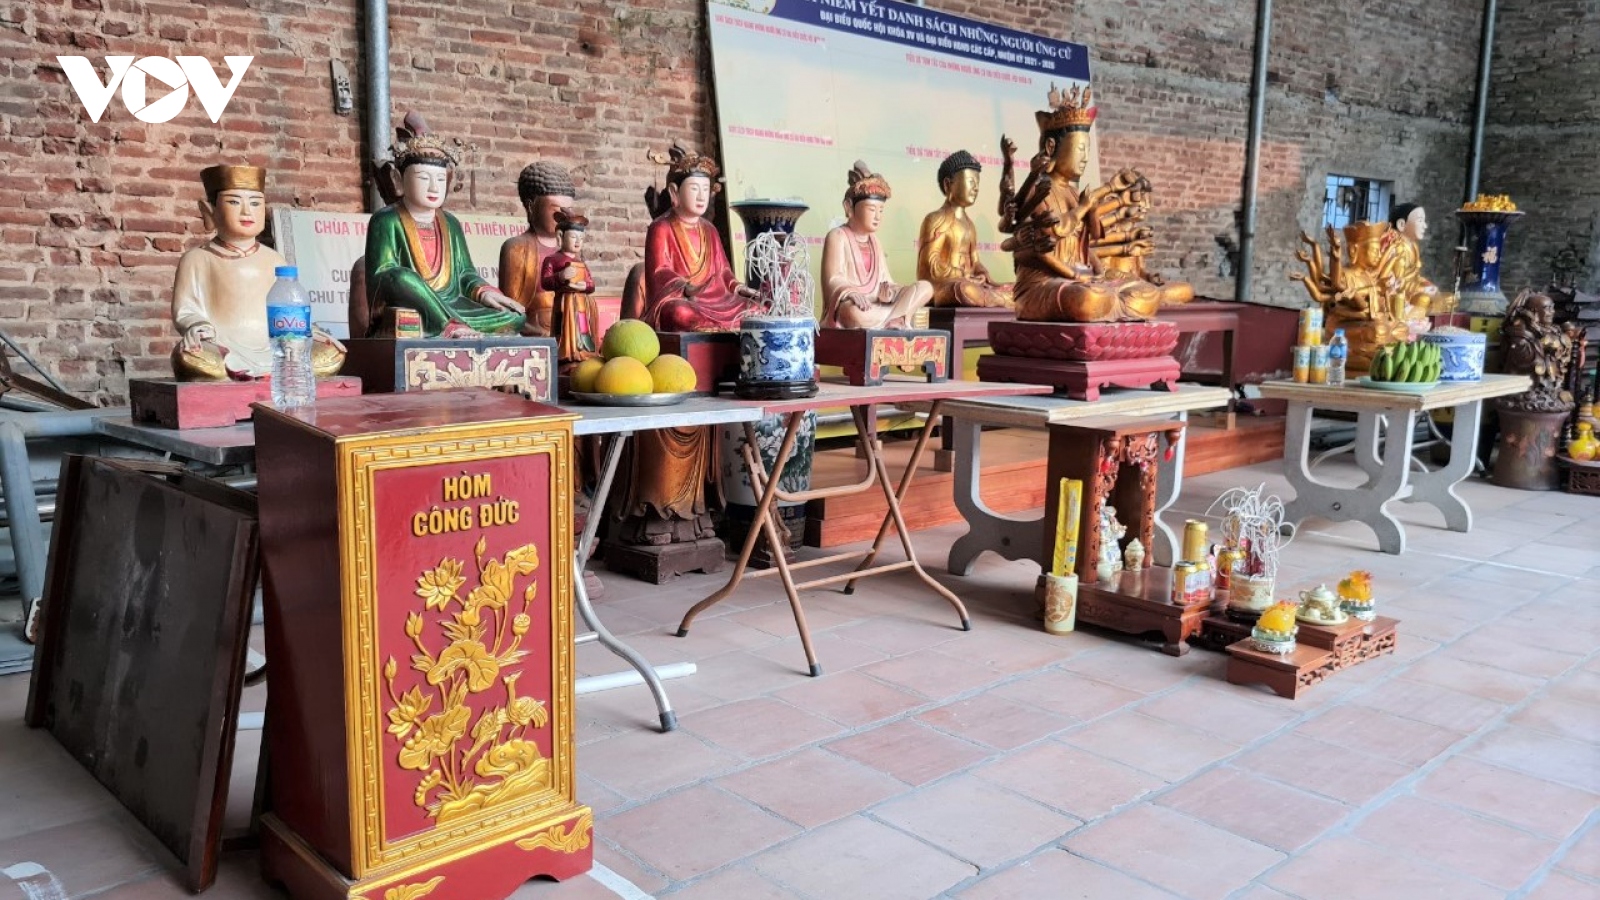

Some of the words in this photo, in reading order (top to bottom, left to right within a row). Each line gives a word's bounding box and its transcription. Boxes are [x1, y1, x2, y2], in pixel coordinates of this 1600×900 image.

[853, 18, 873, 31] QUỐC
[873, 22, 887, 35] HỘI
[859, 0, 886, 18] YẾT
[887, 8, 924, 28] DANH
[925, 17, 957, 35] SÁCH
[959, 25, 998, 45] NHỮNG
[1000, 35, 1034, 53] NGƯỜI
[314, 218, 351, 236] CHÙA
[352, 221, 369, 236] TH
[474, 222, 507, 237] THIÊN
[509, 223, 526, 237] PH
[331, 268, 351, 283] CU
[308, 290, 335, 304] CHU
[442, 470, 491, 502] HÒM
[412, 505, 473, 537] CÔNG
[478, 495, 520, 528] ĐỨC
